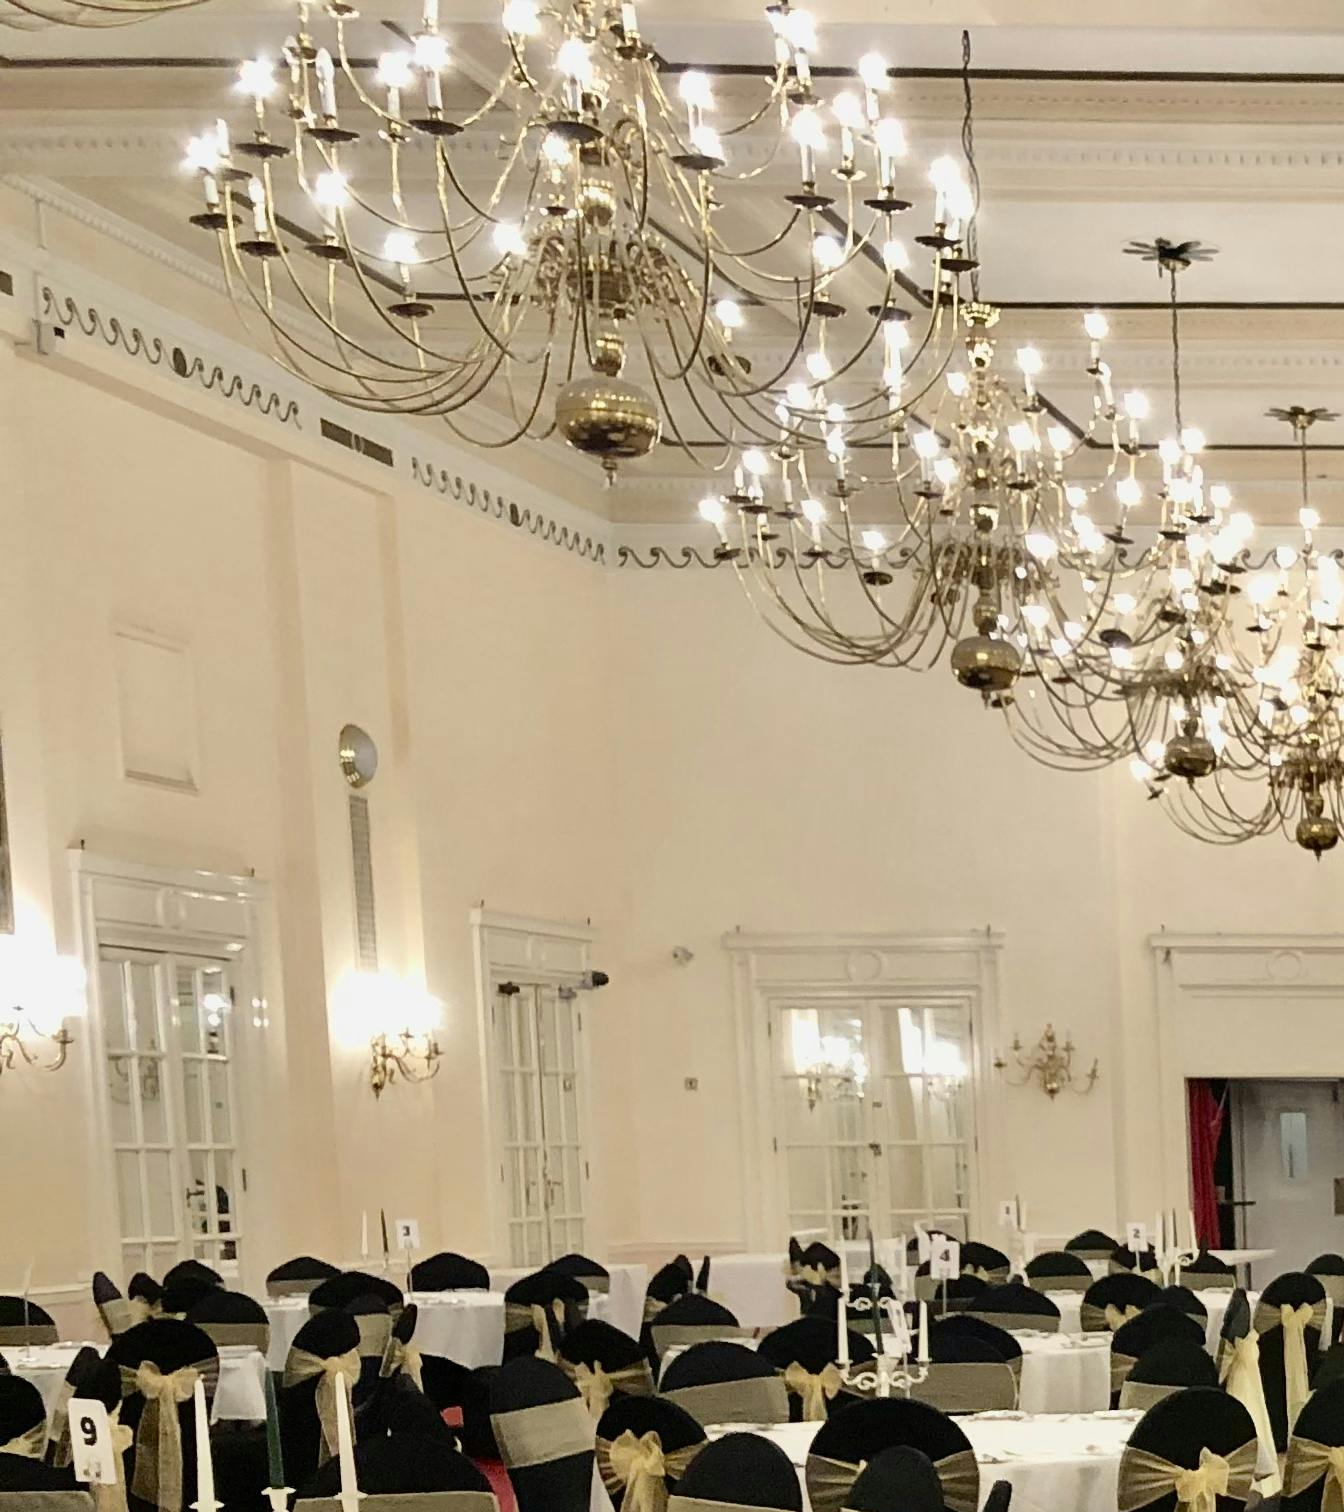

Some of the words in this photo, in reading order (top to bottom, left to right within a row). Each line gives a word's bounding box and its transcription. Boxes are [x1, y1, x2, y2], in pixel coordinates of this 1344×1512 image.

[1133, 1228, 1141, 1239] 2
[939, 1249, 949, 1262] 4
[80, 1416, 97, 1446] 9
